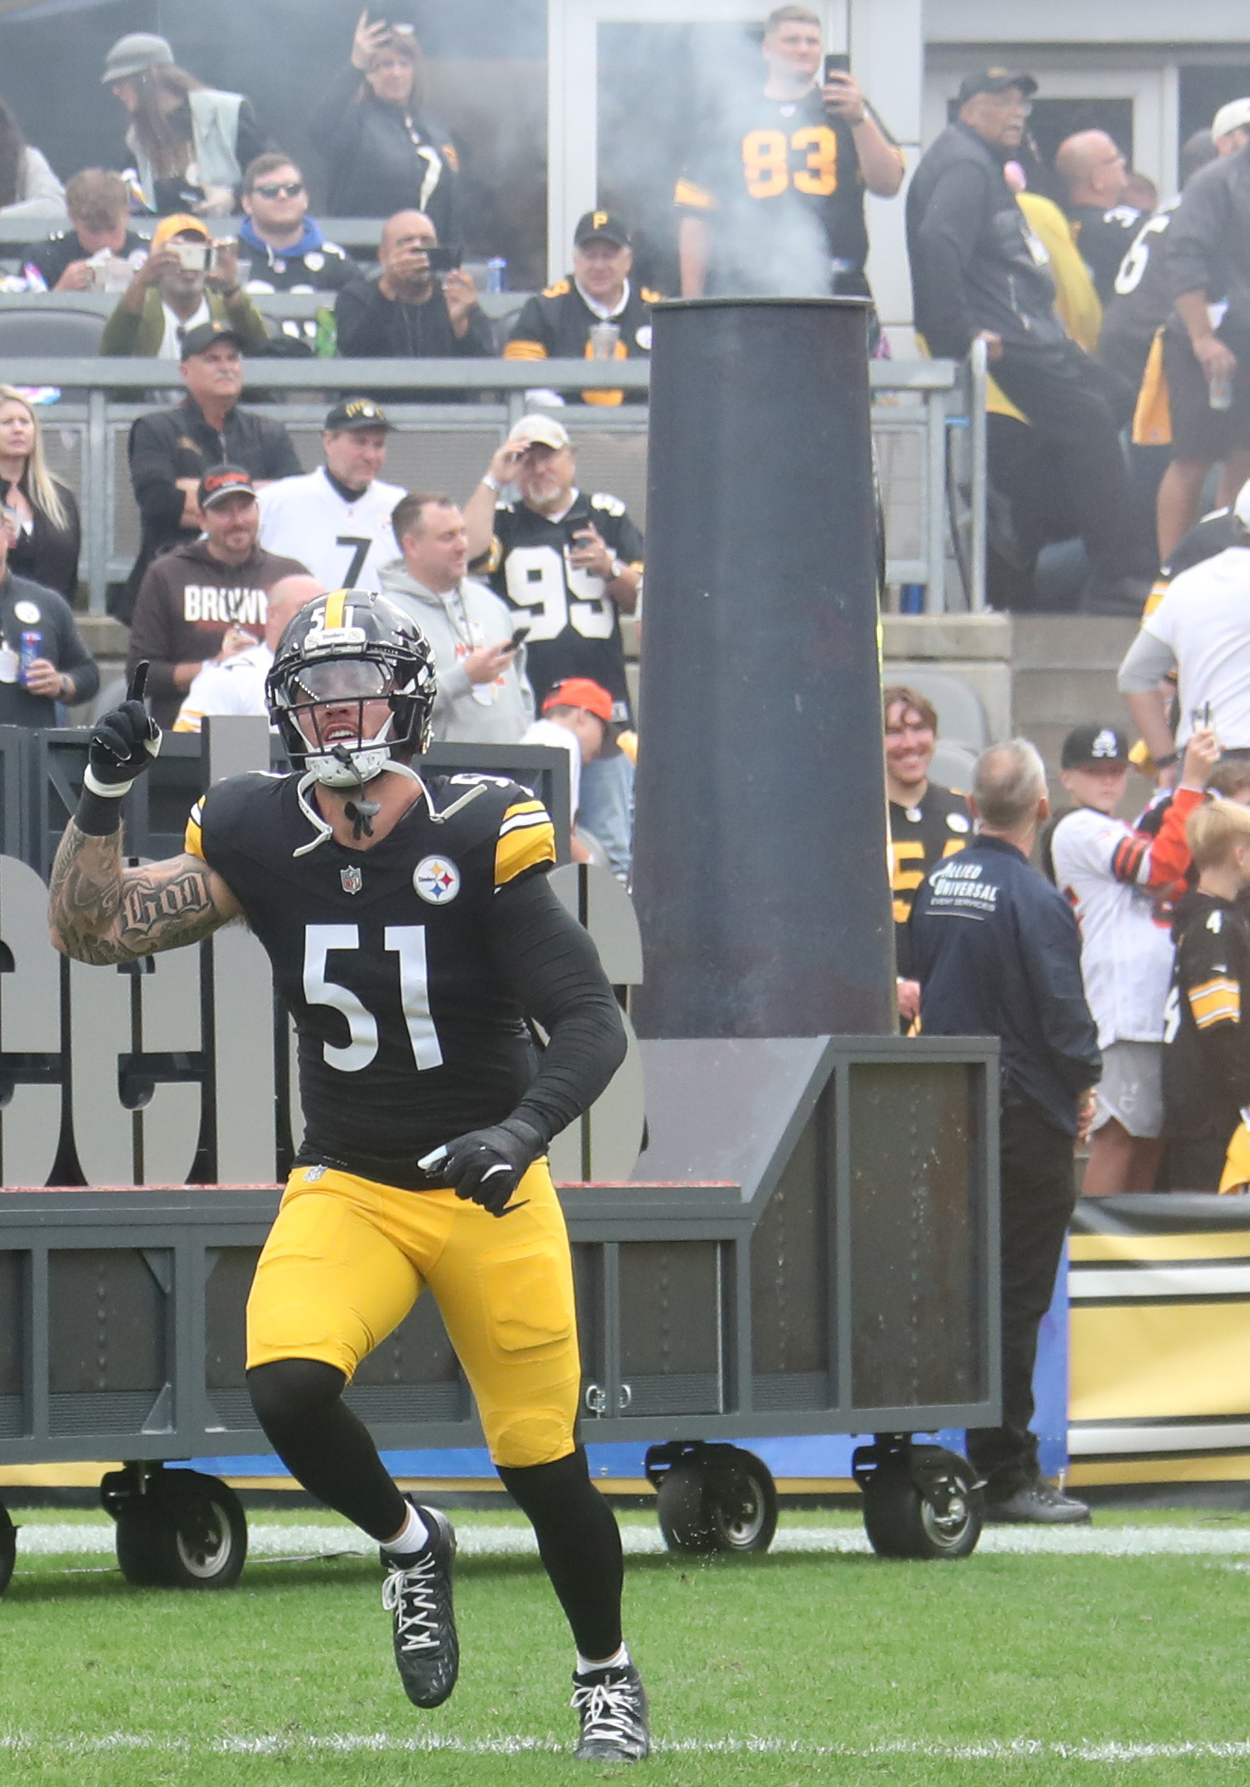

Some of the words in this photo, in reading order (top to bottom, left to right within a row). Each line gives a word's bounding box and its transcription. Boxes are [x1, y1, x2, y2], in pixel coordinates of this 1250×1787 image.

[742, 126, 838, 199] 83
[336, 536, 373, 589] 7
[505, 543, 615, 640] 95
[303, 923, 444, 1072] 51
